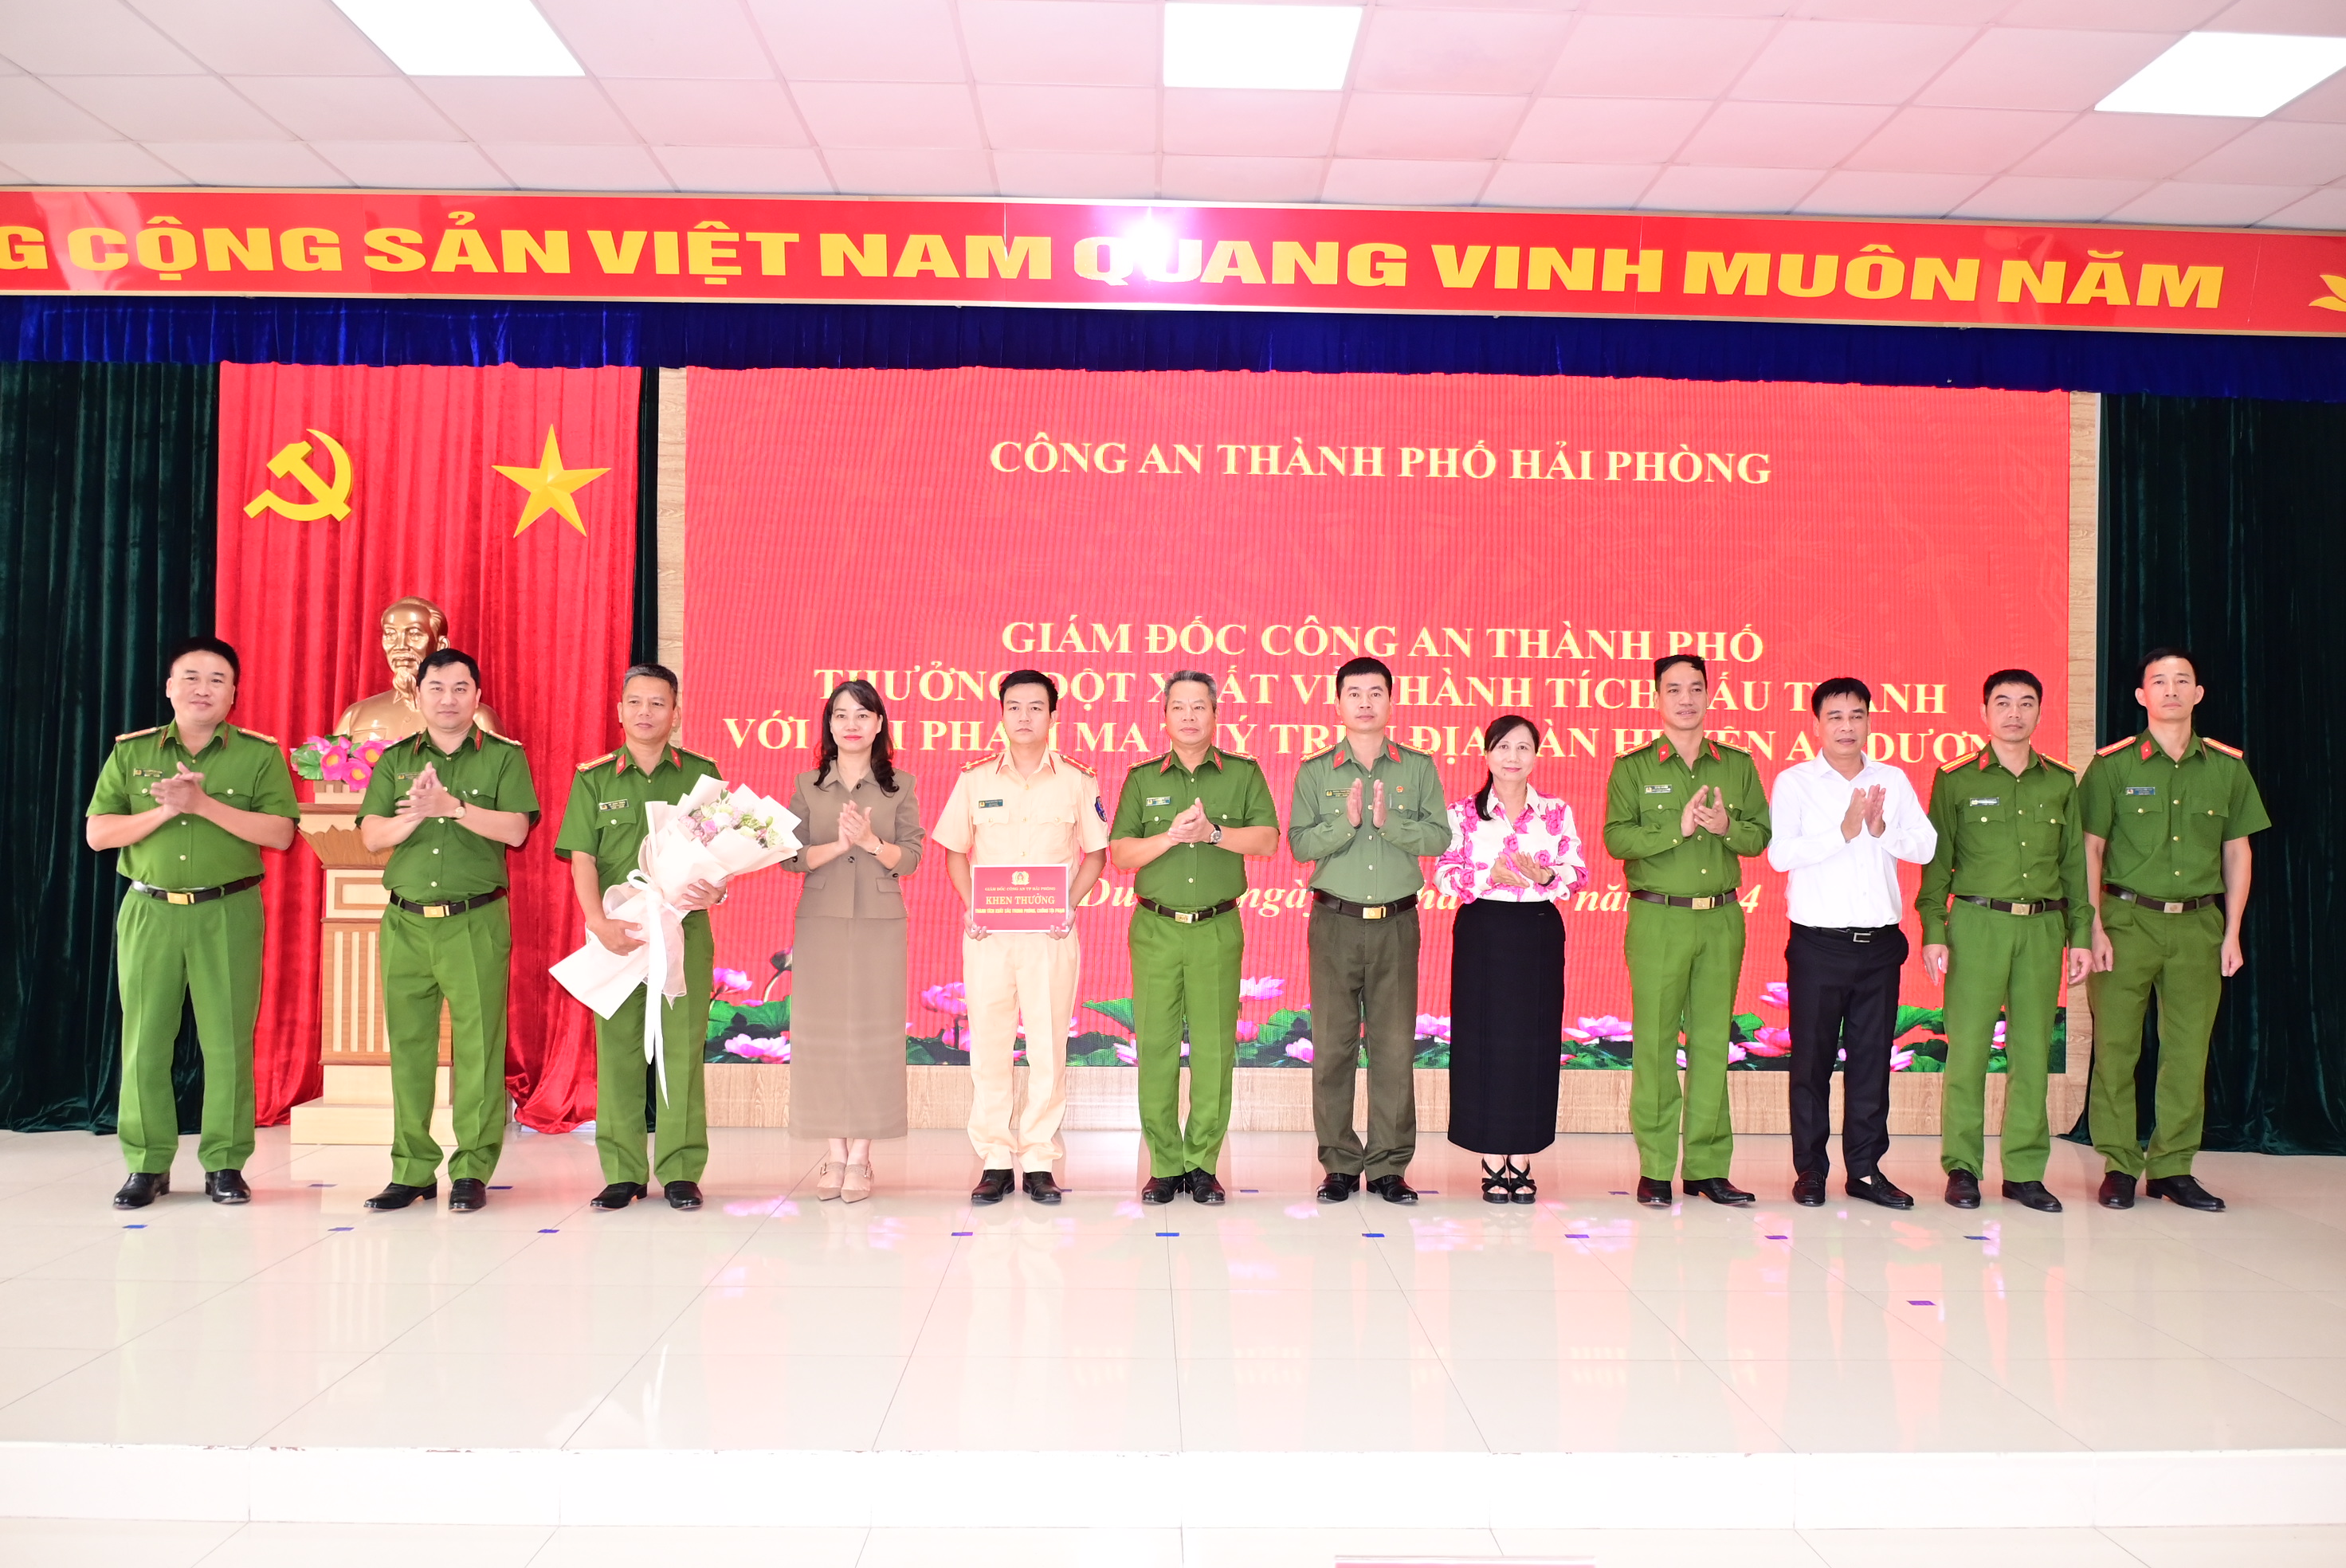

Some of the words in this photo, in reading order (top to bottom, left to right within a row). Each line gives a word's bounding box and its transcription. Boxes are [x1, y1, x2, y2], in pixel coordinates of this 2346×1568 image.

[67, 216, 343, 280] CỘNG
[364, 211, 571, 273] SẢN
[587, 221, 800, 284] VIỆT
[820, 233, 1052, 280] NAM
[1073, 236, 1407, 288] QUANG
[1431, 244, 1663, 292] VINH
[1683, 244, 1979, 301] MUÔN
[1998, 250, 2224, 308] NĂM
[990, 431, 1129, 473] CÔNG
[1137, 443, 1204, 474] AN
[1217, 437, 1385, 476] THÀNH
[1397, 440, 1497, 479] PHỐ
[1508, 441, 1595, 480] HẢI
[1604, 444, 1771, 484] PHÒNG
[1002, 614, 1132, 653] GIÁM
[1144, 615, 1247, 656] ĐỐC
[1261, 614, 1399, 657] CÔNG
[1407, 626, 1473, 658] AN
[1486, 621, 1654, 661] THÀNH
[1668, 623, 1763, 663] PHỐ
[1393, 668, 1533, 708] HÀNH
[723, 710, 810, 750] VỚI
[1073, 722, 1151, 752] MA
[1537, 719, 1600, 759] ÀN
[986, 896, 1013, 905] KHEN
[1014, 892, 1055, 905] THƯỞNG
